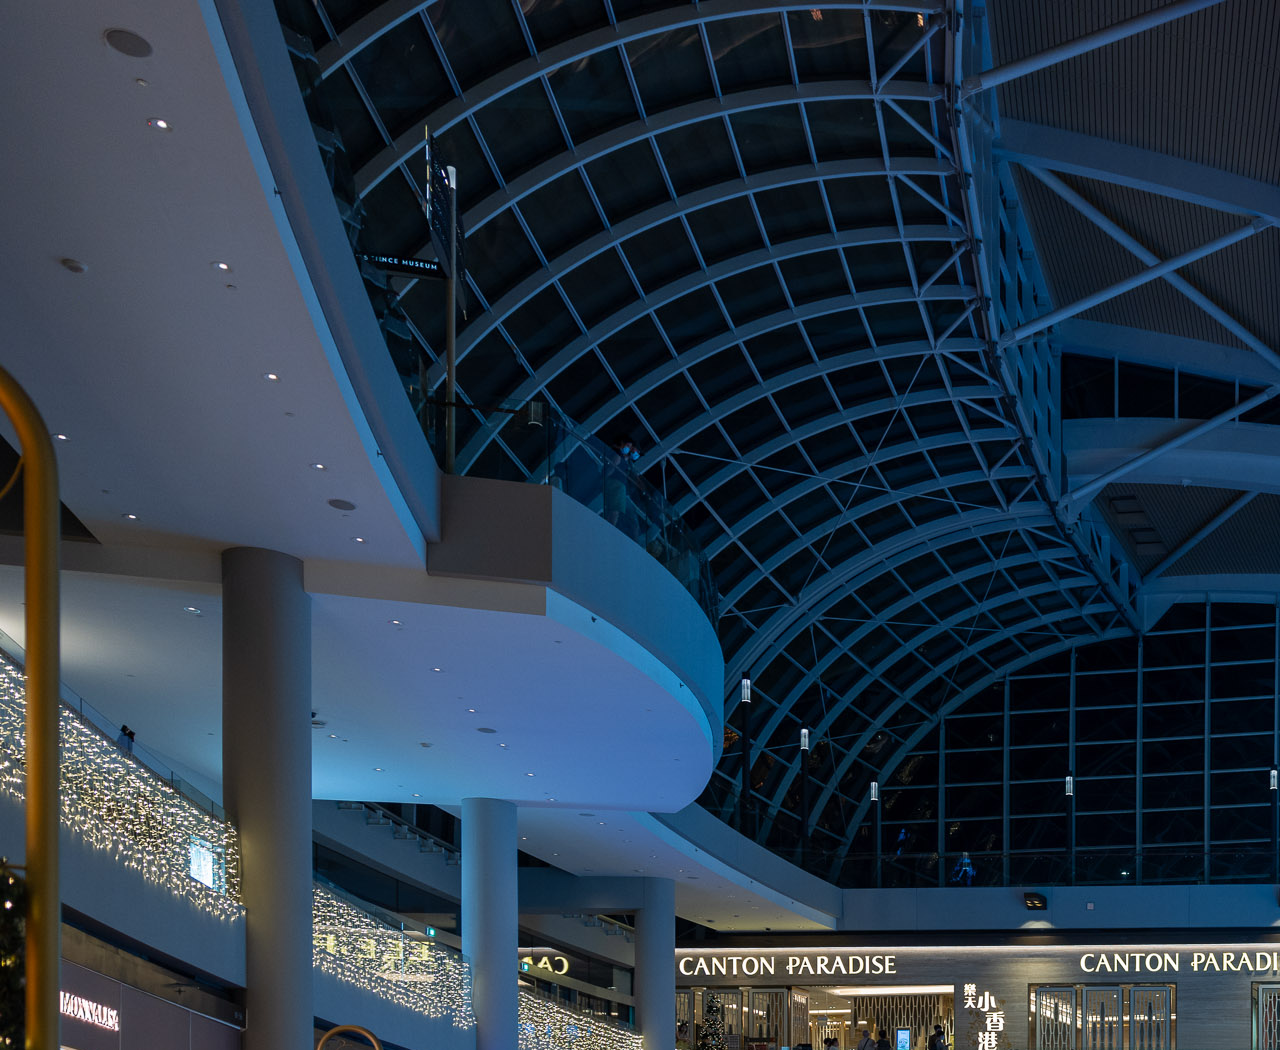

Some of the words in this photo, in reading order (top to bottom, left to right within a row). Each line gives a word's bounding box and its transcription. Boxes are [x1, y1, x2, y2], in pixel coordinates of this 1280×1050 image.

[363, 254, 399, 264] SIENCE
[402, 259, 438, 270] MUSEUM
[679, 956, 776, 976] CANTON
[786, 954, 897, 976] PARADISE
[1079, 952, 1180, 973] CANTON
[59, 990, 120, 1032] MONNALISA
